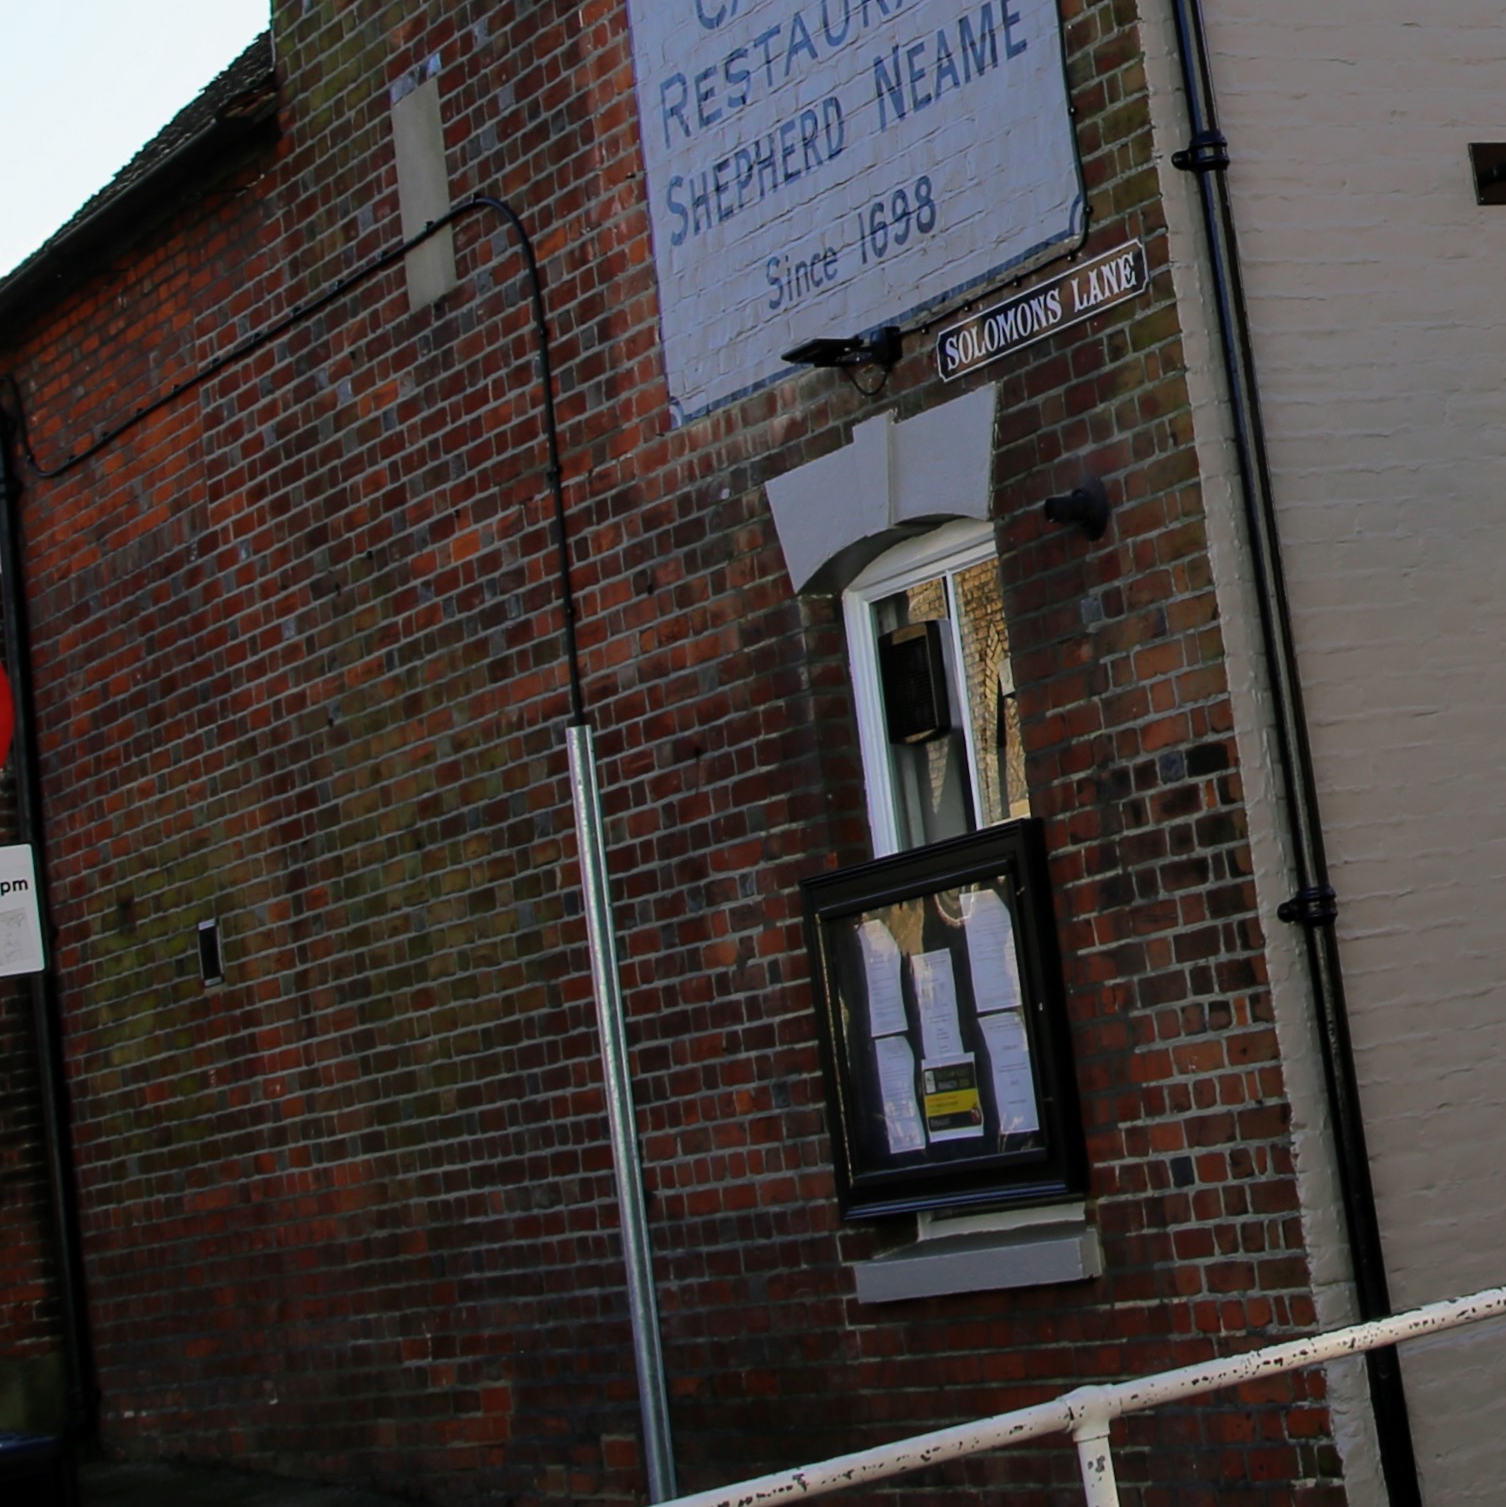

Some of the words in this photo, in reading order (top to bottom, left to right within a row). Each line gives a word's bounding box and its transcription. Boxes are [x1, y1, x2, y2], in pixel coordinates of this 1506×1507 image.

[670, 96, 844, 246] SHEPHERD
[766, 244, 838, 310] Since
[859, 175, 937, 263] 1698
[946, 288, 1062, 371] SOLOMONS
[1071, 252, 1136, 312] LANE
